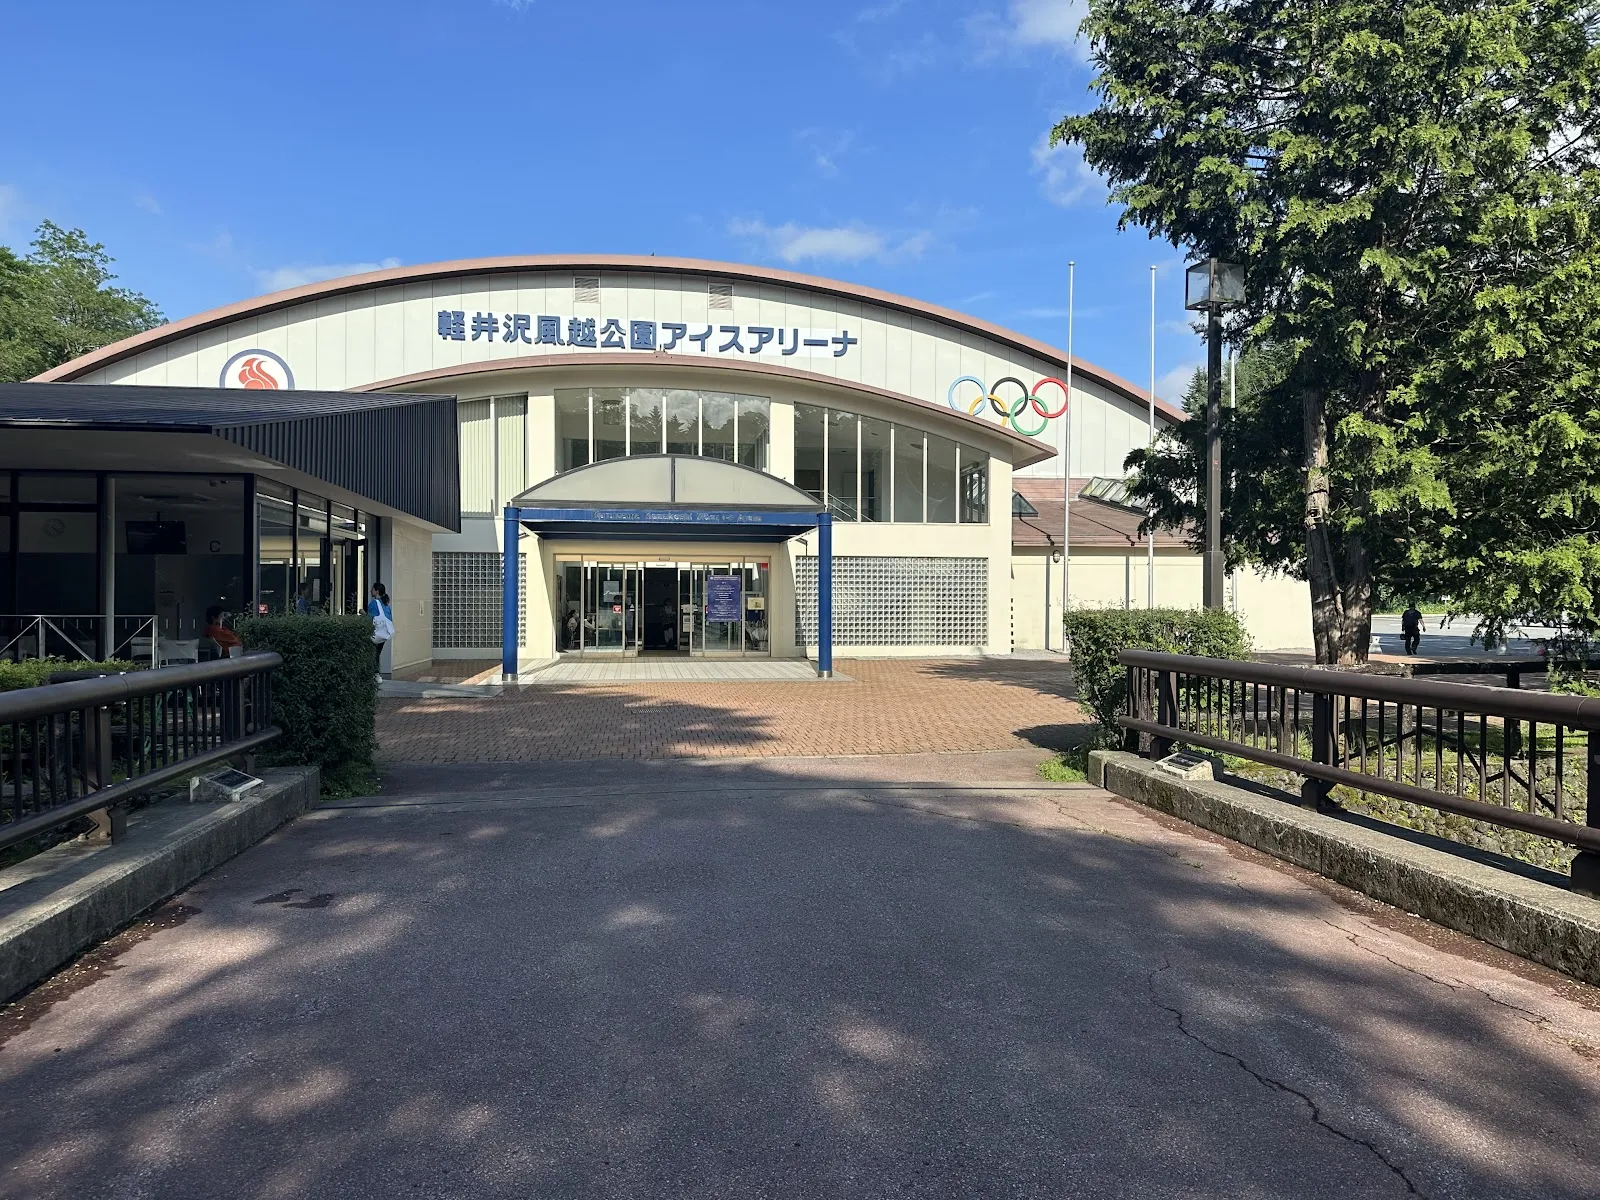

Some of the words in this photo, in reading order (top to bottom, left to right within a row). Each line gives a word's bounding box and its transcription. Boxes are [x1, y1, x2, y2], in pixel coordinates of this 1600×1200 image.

[437, 309, 859, 358] 軽井沢風越公園アイスアリーナ
